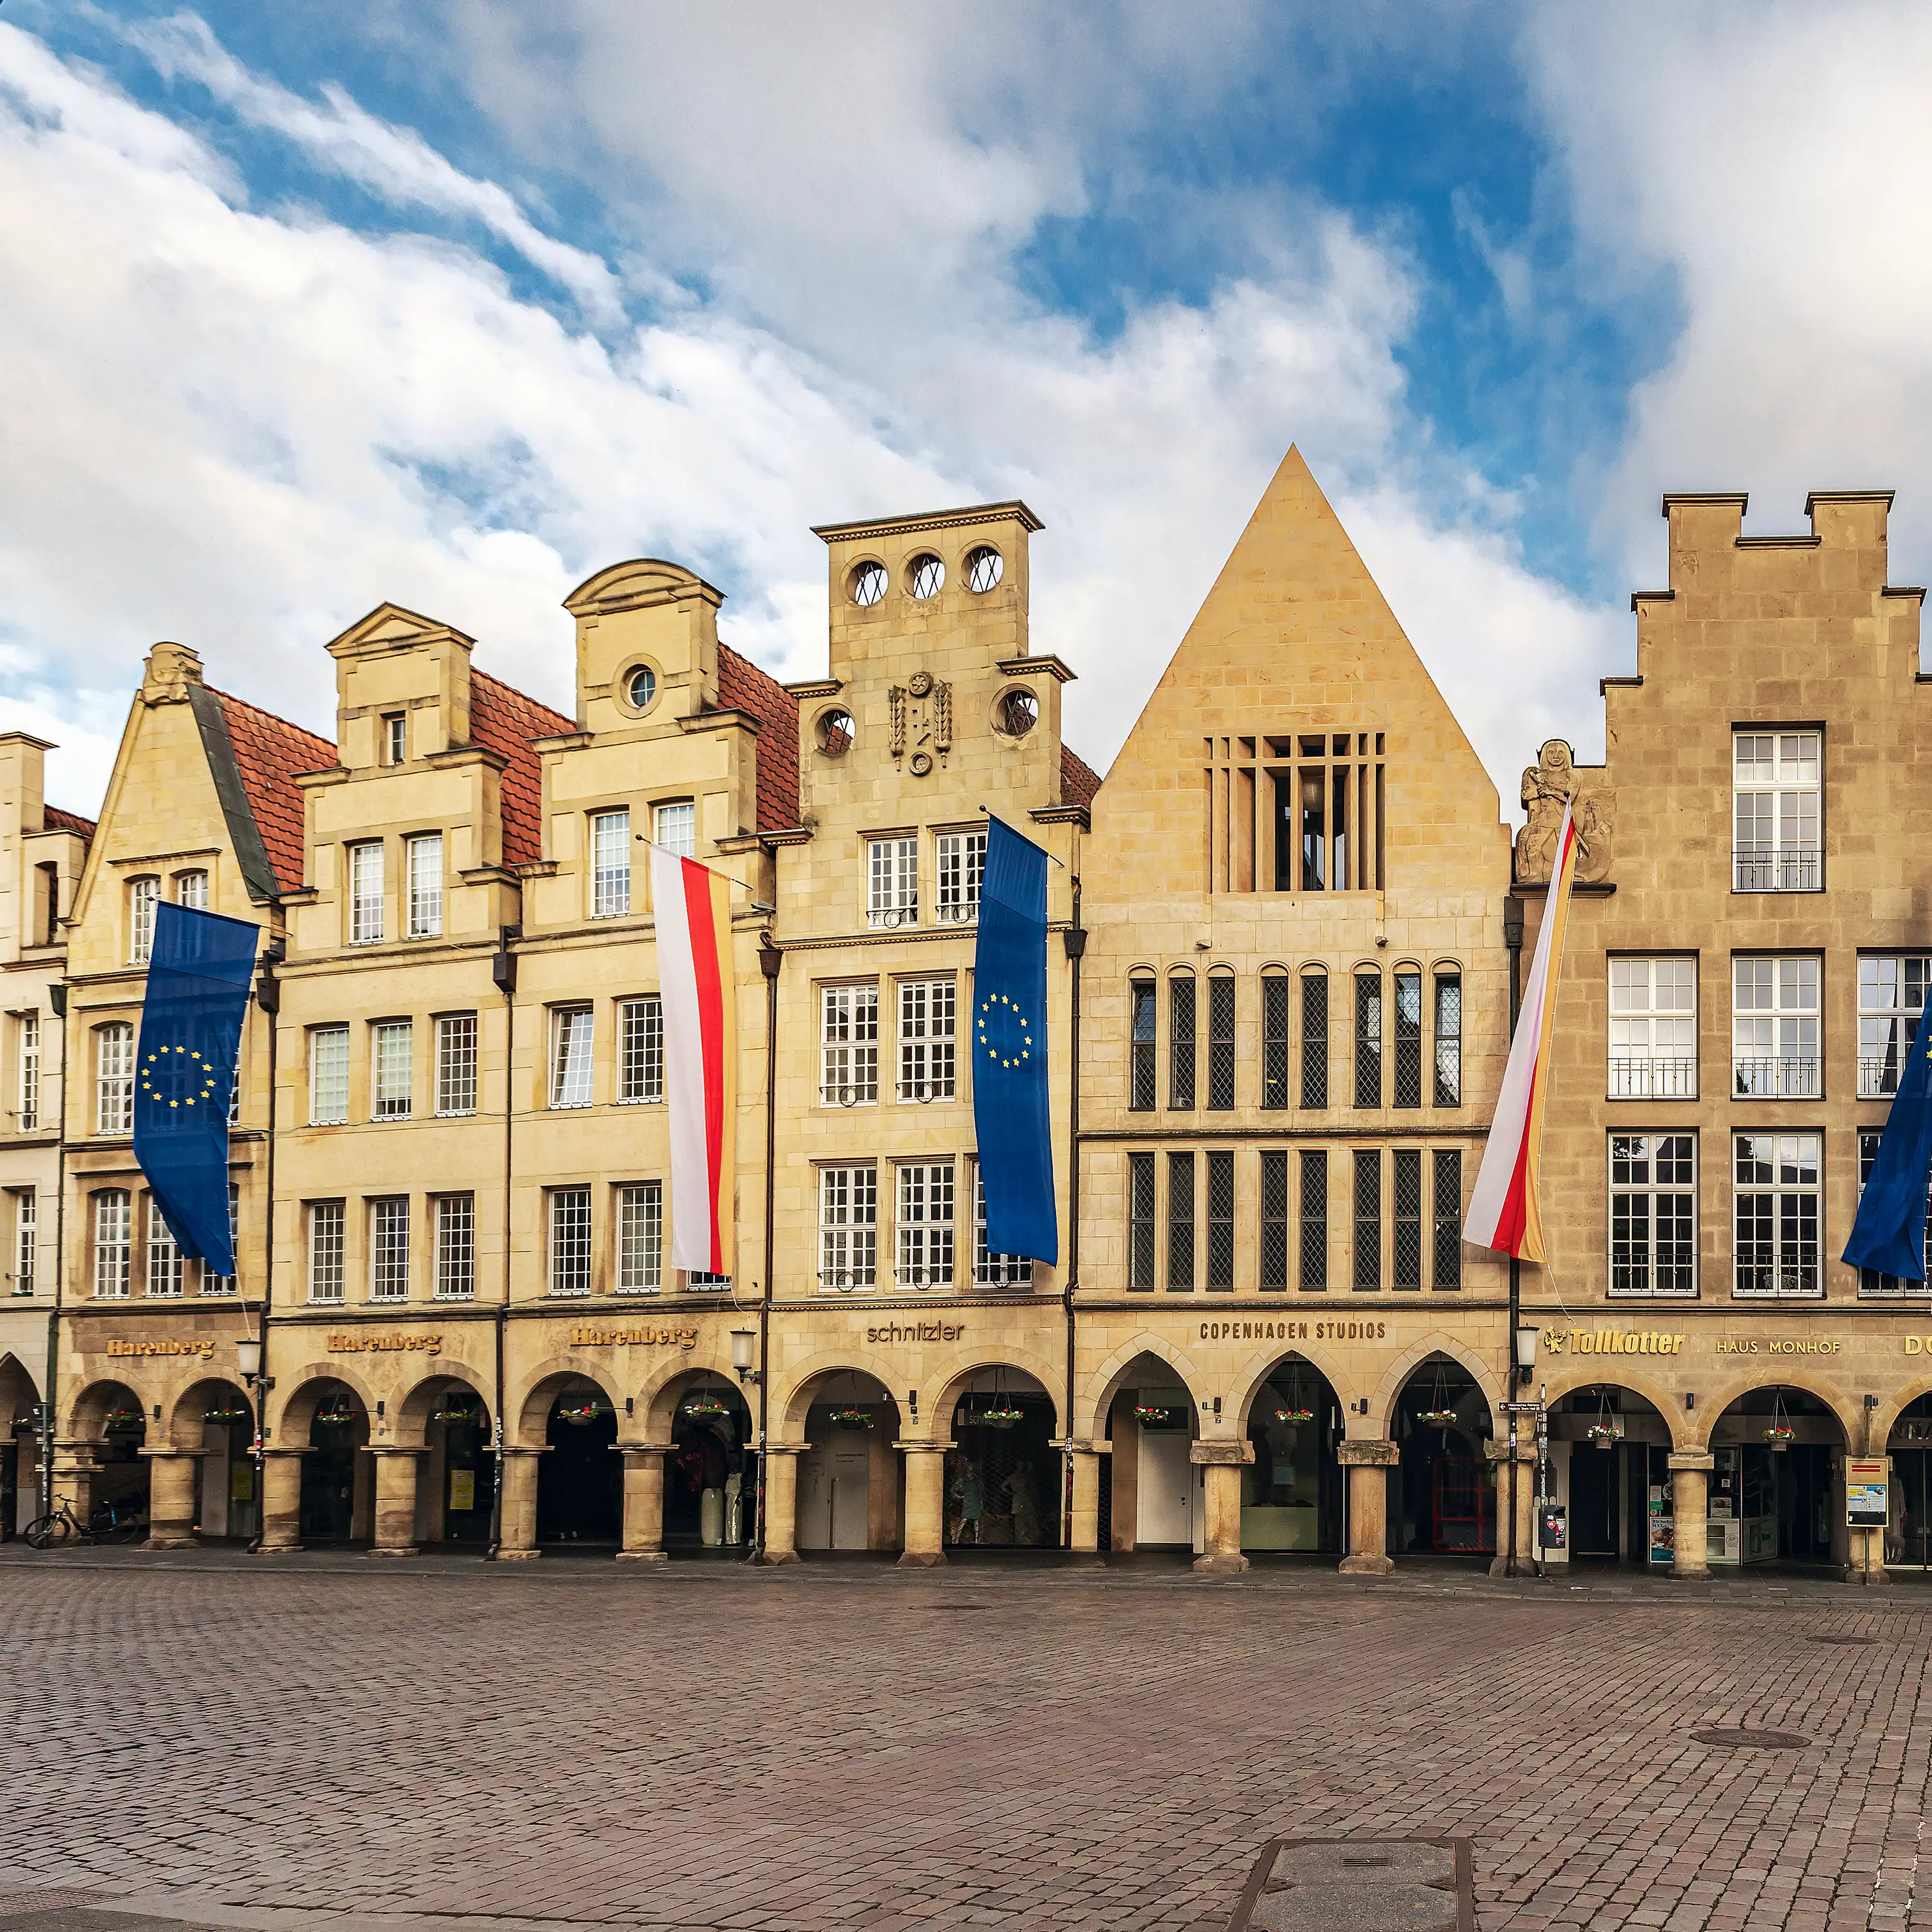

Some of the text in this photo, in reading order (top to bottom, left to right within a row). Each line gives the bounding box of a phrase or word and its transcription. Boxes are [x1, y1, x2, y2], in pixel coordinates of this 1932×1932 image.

[570, 1326, 697, 1349] Harenberg
[867, 1320, 965, 1343] schnitzler
[1200, 1322, 1385, 1339] COPENHAGEN STUDIOS
[1570, 1328, 1685, 1354] Tollkötter
[108, 1338, 215, 1359] Harenberg
[328, 1332, 443, 1355] Harenberg
[1717, 1341, 1840, 1354] HAUS MONHOF
